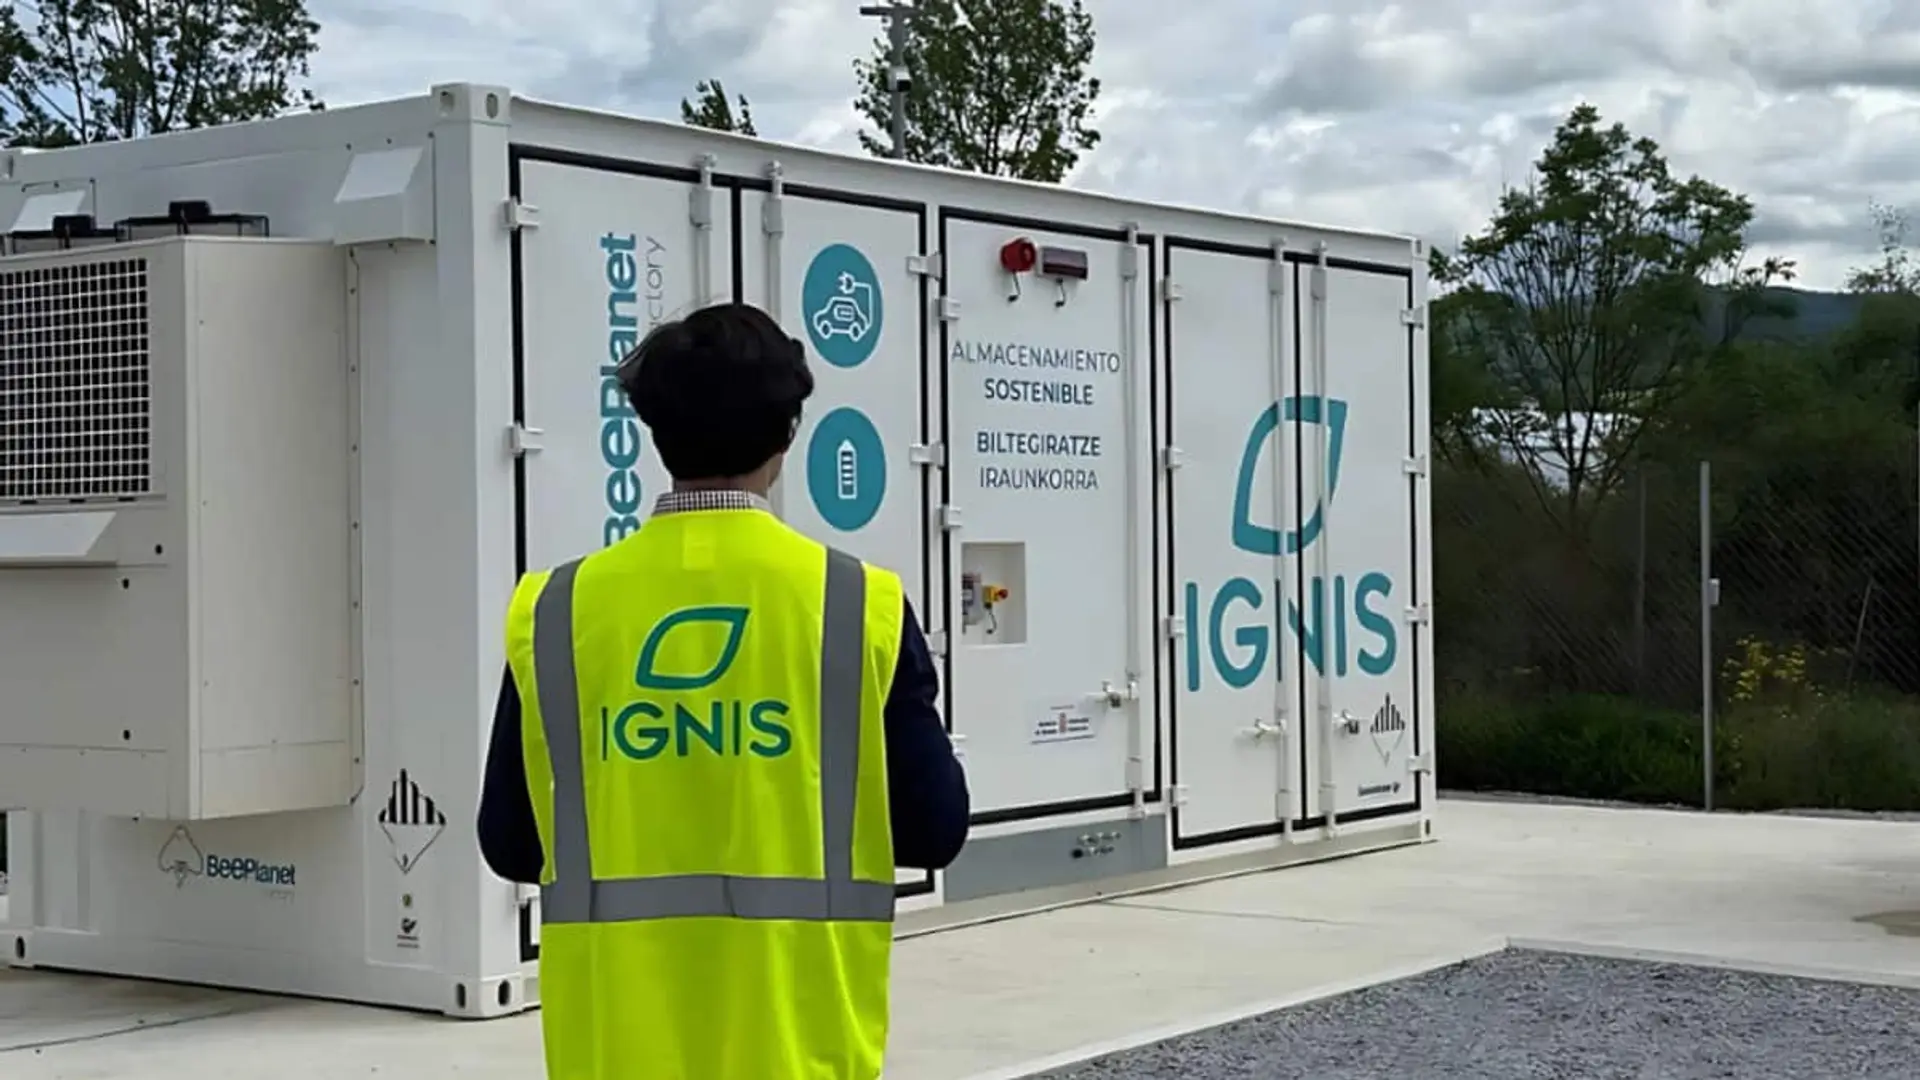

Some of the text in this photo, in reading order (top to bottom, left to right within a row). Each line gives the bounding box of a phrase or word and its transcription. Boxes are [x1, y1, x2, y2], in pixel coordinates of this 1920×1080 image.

[952, 340, 1121, 373] ALMACENAMIENTO
[984, 378, 1093, 405] SOSTENIBLE
[977, 431, 1101, 456] BILTEGIRATZE
[980, 467, 1099, 490] IRAUNKORRA
[1185, 572, 1396, 692] IGNIS
[601, 700, 792, 761] IGNIS
[206, 854, 296, 885] BeePlanet
